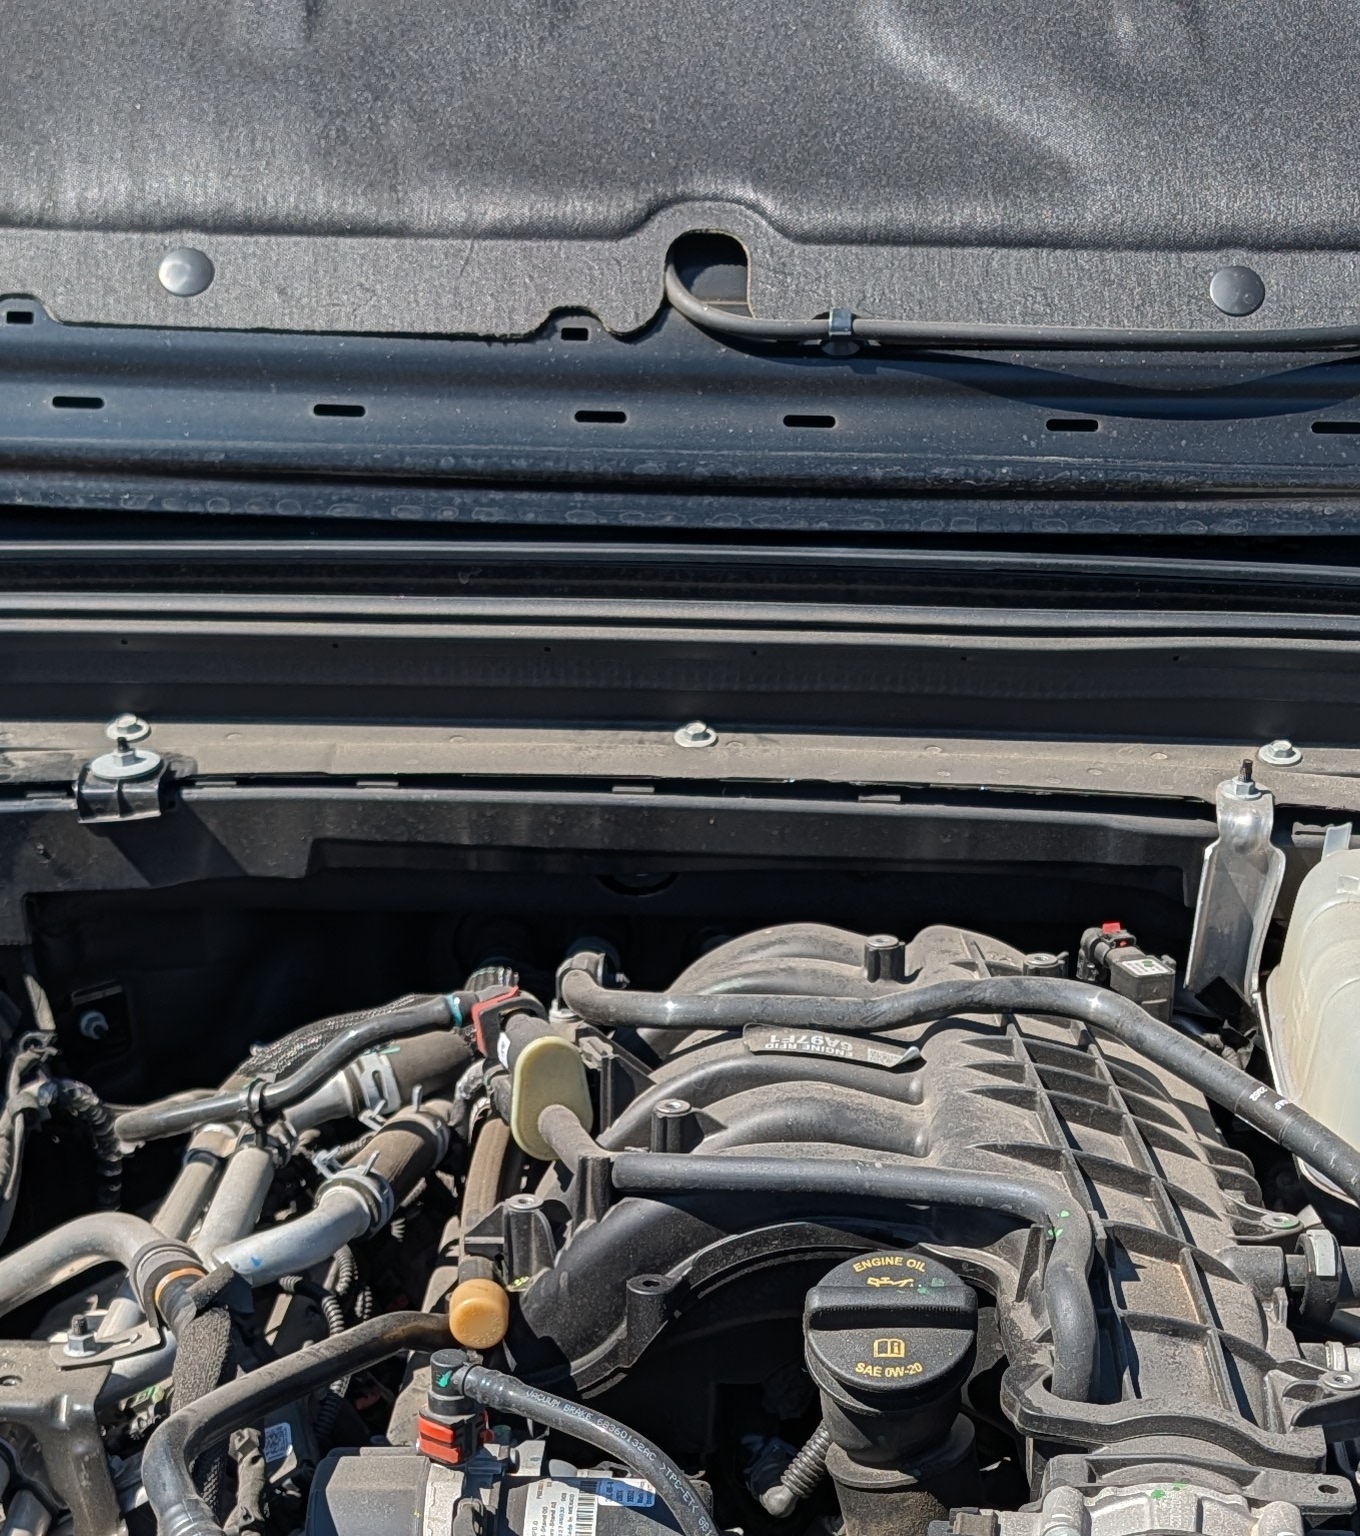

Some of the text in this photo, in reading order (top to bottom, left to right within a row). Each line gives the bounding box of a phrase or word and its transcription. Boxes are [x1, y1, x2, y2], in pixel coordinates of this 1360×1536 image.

[765, 1041, 854, 1057] ENGINE RFID
[769, 1034, 854, 1051] 6A97F1
[852, 1256, 927, 1274] ENGINE OIL
[855, 1362, 923, 1378] SAE 0W-20
[525, 1388, 562, 1408] VACUUM
[563, 1404, 594, 1422] BRAKE
[596, 1416, 658, 1463] 68360132AC
